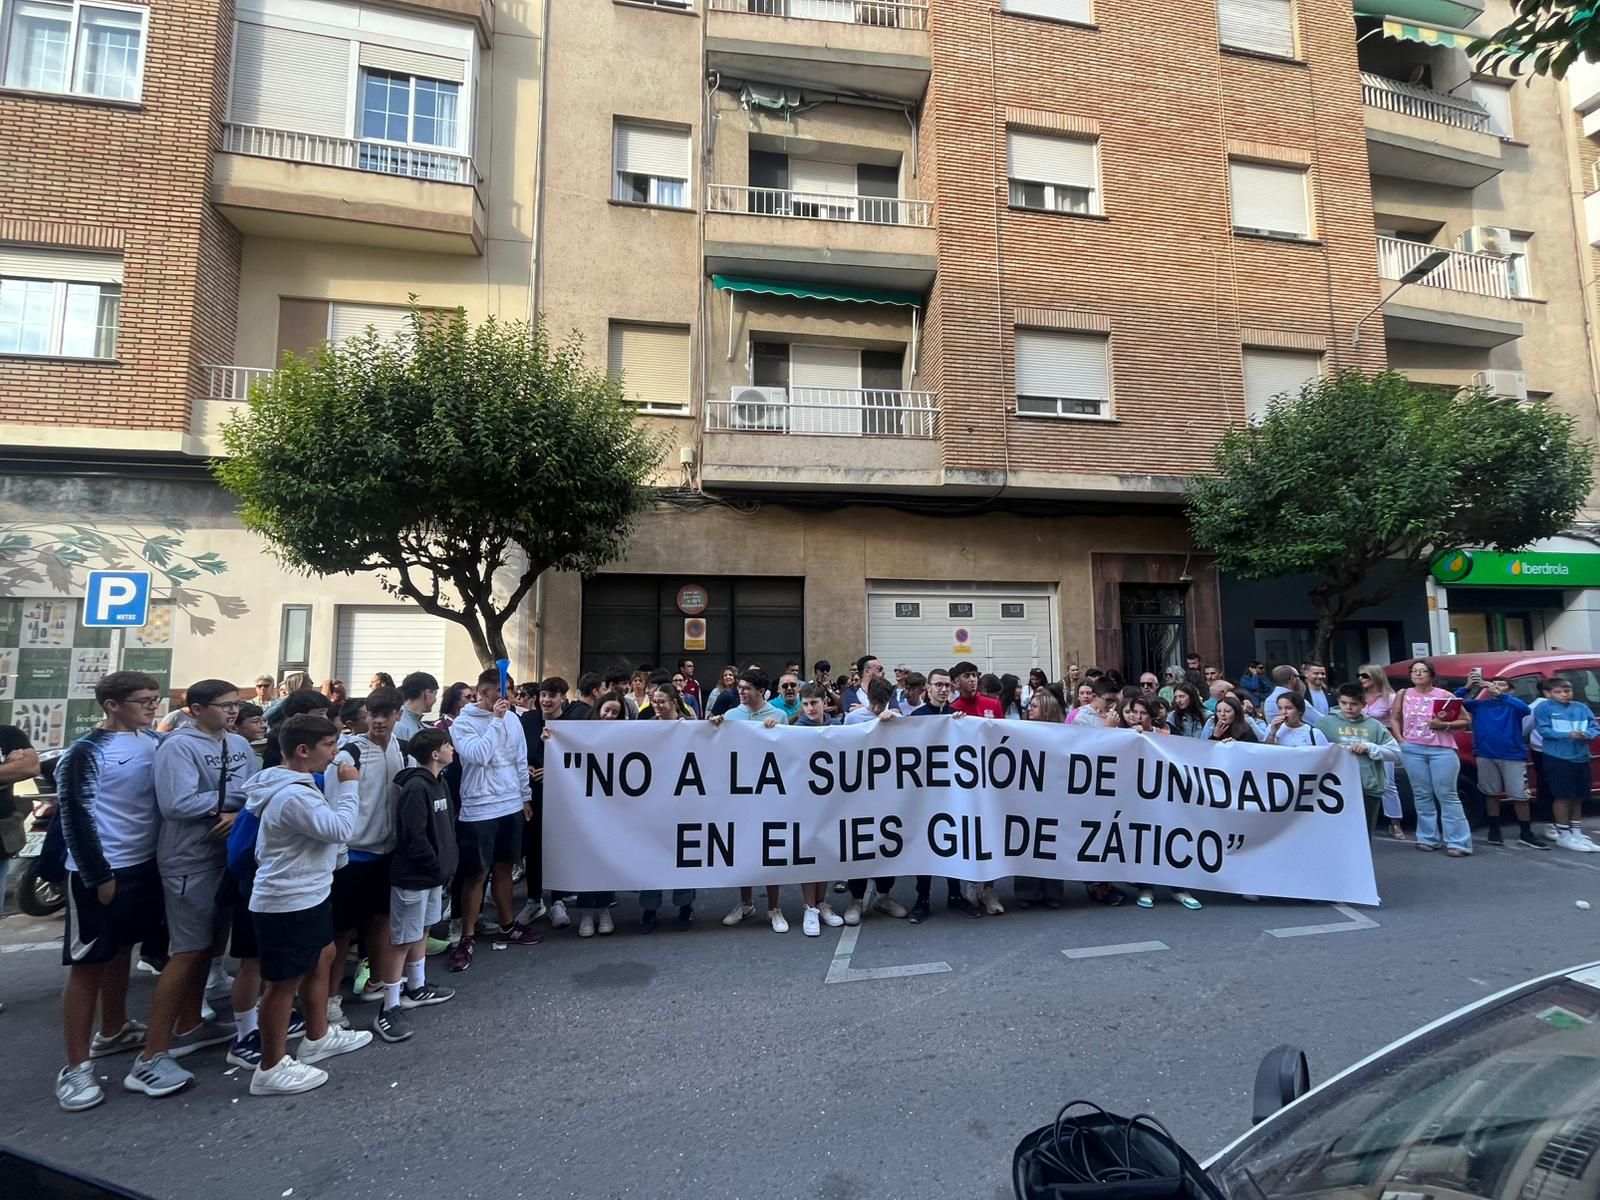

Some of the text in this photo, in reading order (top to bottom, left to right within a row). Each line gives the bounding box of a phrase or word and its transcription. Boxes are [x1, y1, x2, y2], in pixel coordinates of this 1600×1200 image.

[1521, 562, 1569, 575] Iberdrola
[96, 576, 137, 620] P
[564, 736, 1345, 815] "NO A LA SUPRESIÓN DE UNIDADES
[676, 821, 735, 868] EN
[762, 821, 816, 867] EL
[839, 815, 904, 863] IES
[927, 812, 993, 862] GIL
[1005, 814, 1059, 861] DE
